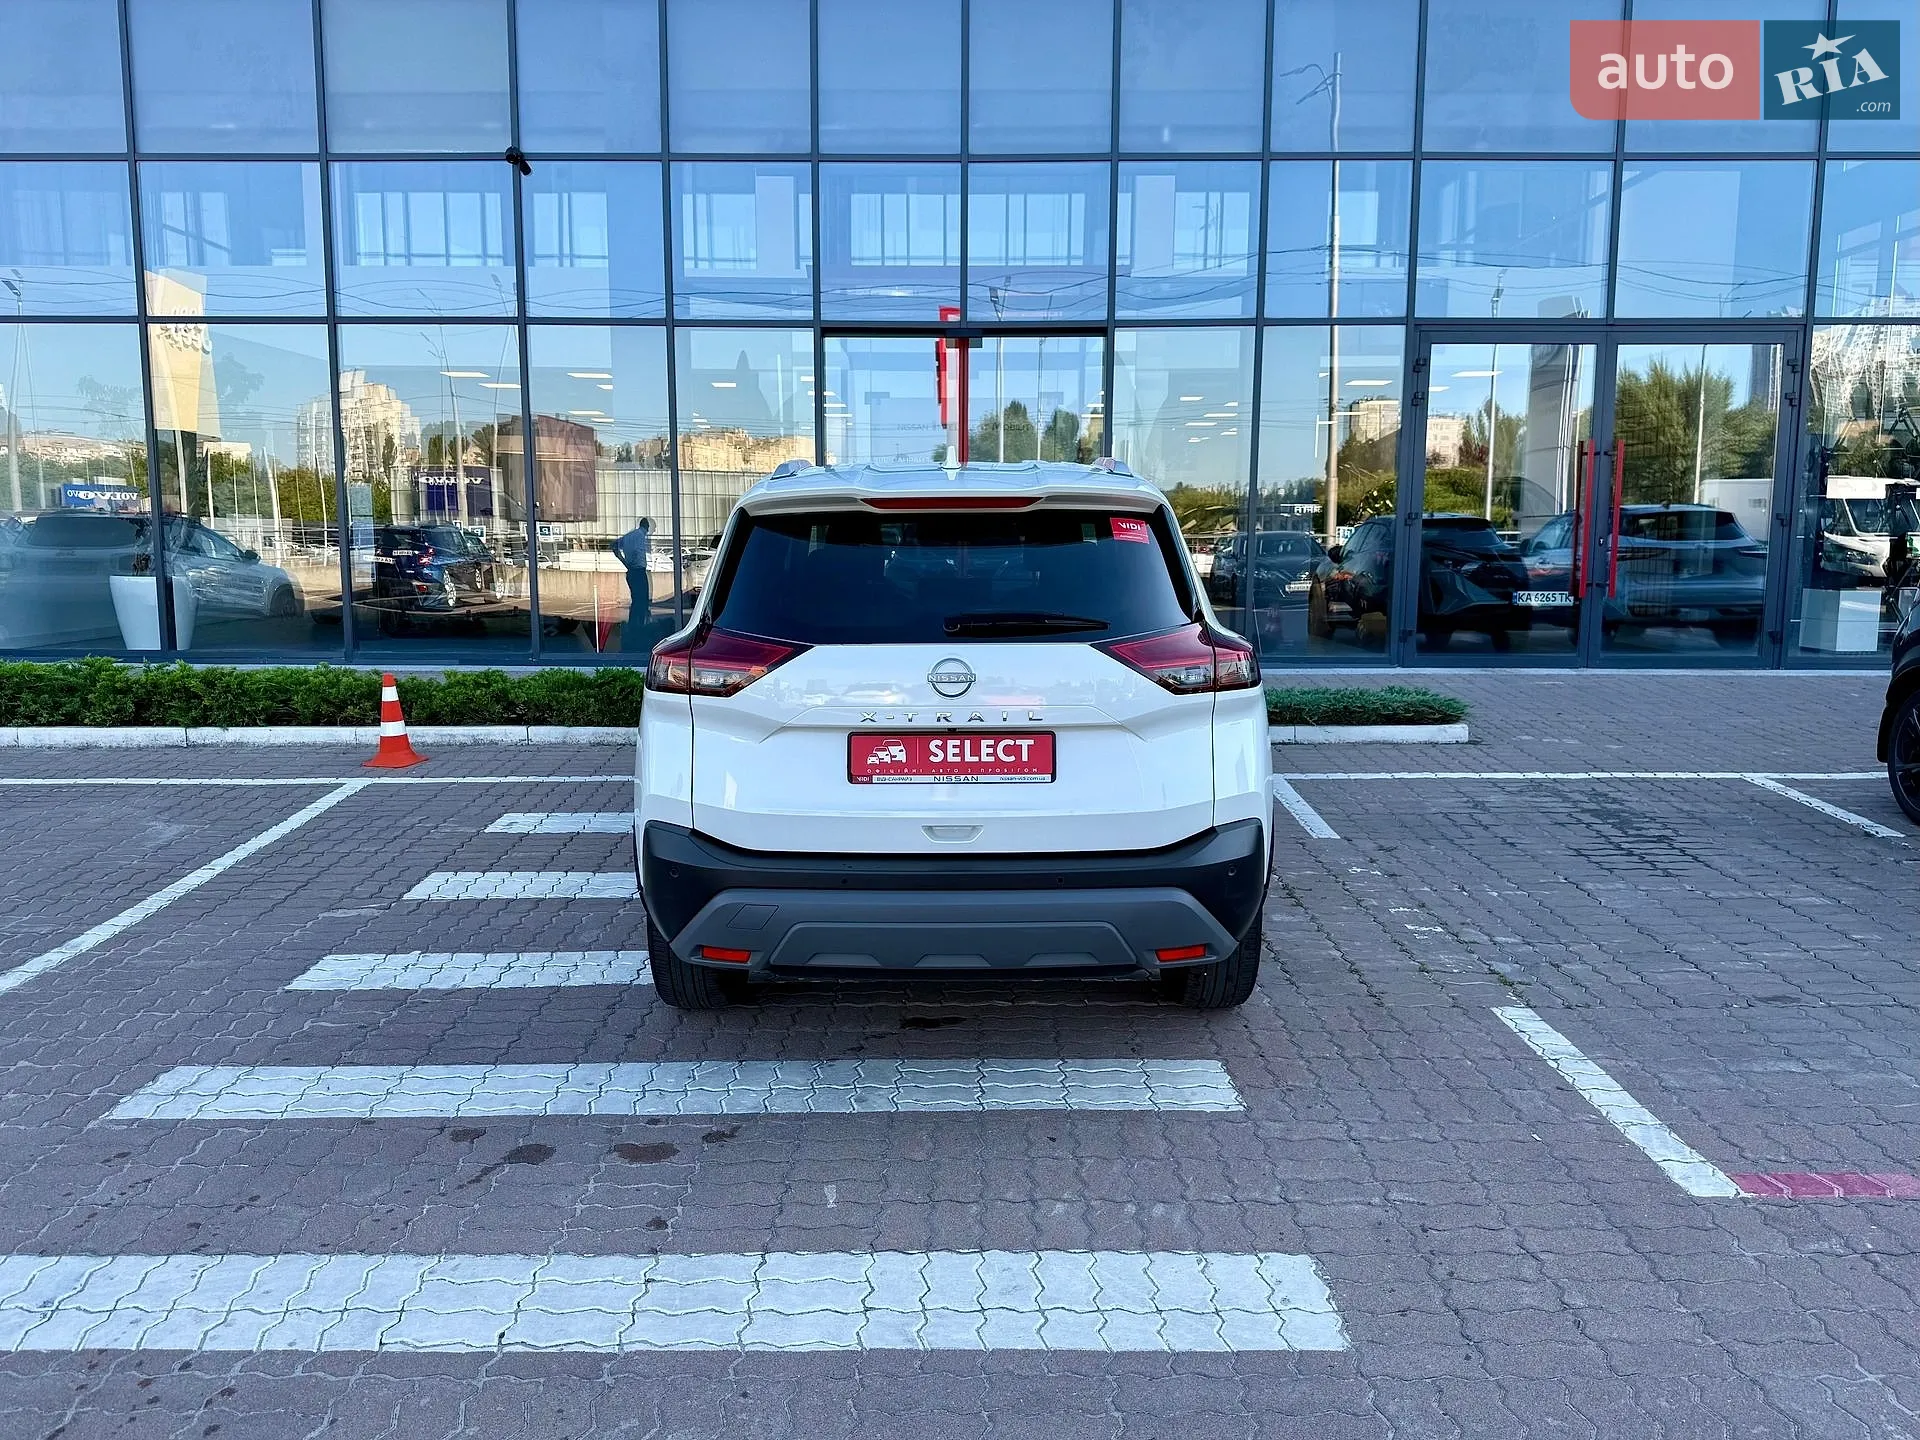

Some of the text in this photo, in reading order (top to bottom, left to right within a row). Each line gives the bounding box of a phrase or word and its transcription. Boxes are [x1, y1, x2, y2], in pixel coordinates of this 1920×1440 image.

[1118, 522, 1141, 531] VIDI
[1517, 593, 1532, 602] KA
[928, 674, 975, 682] NISSAN
[860, 711, 1043, 722] X-TRAIL
[928, 739, 1035, 763] SELECT
